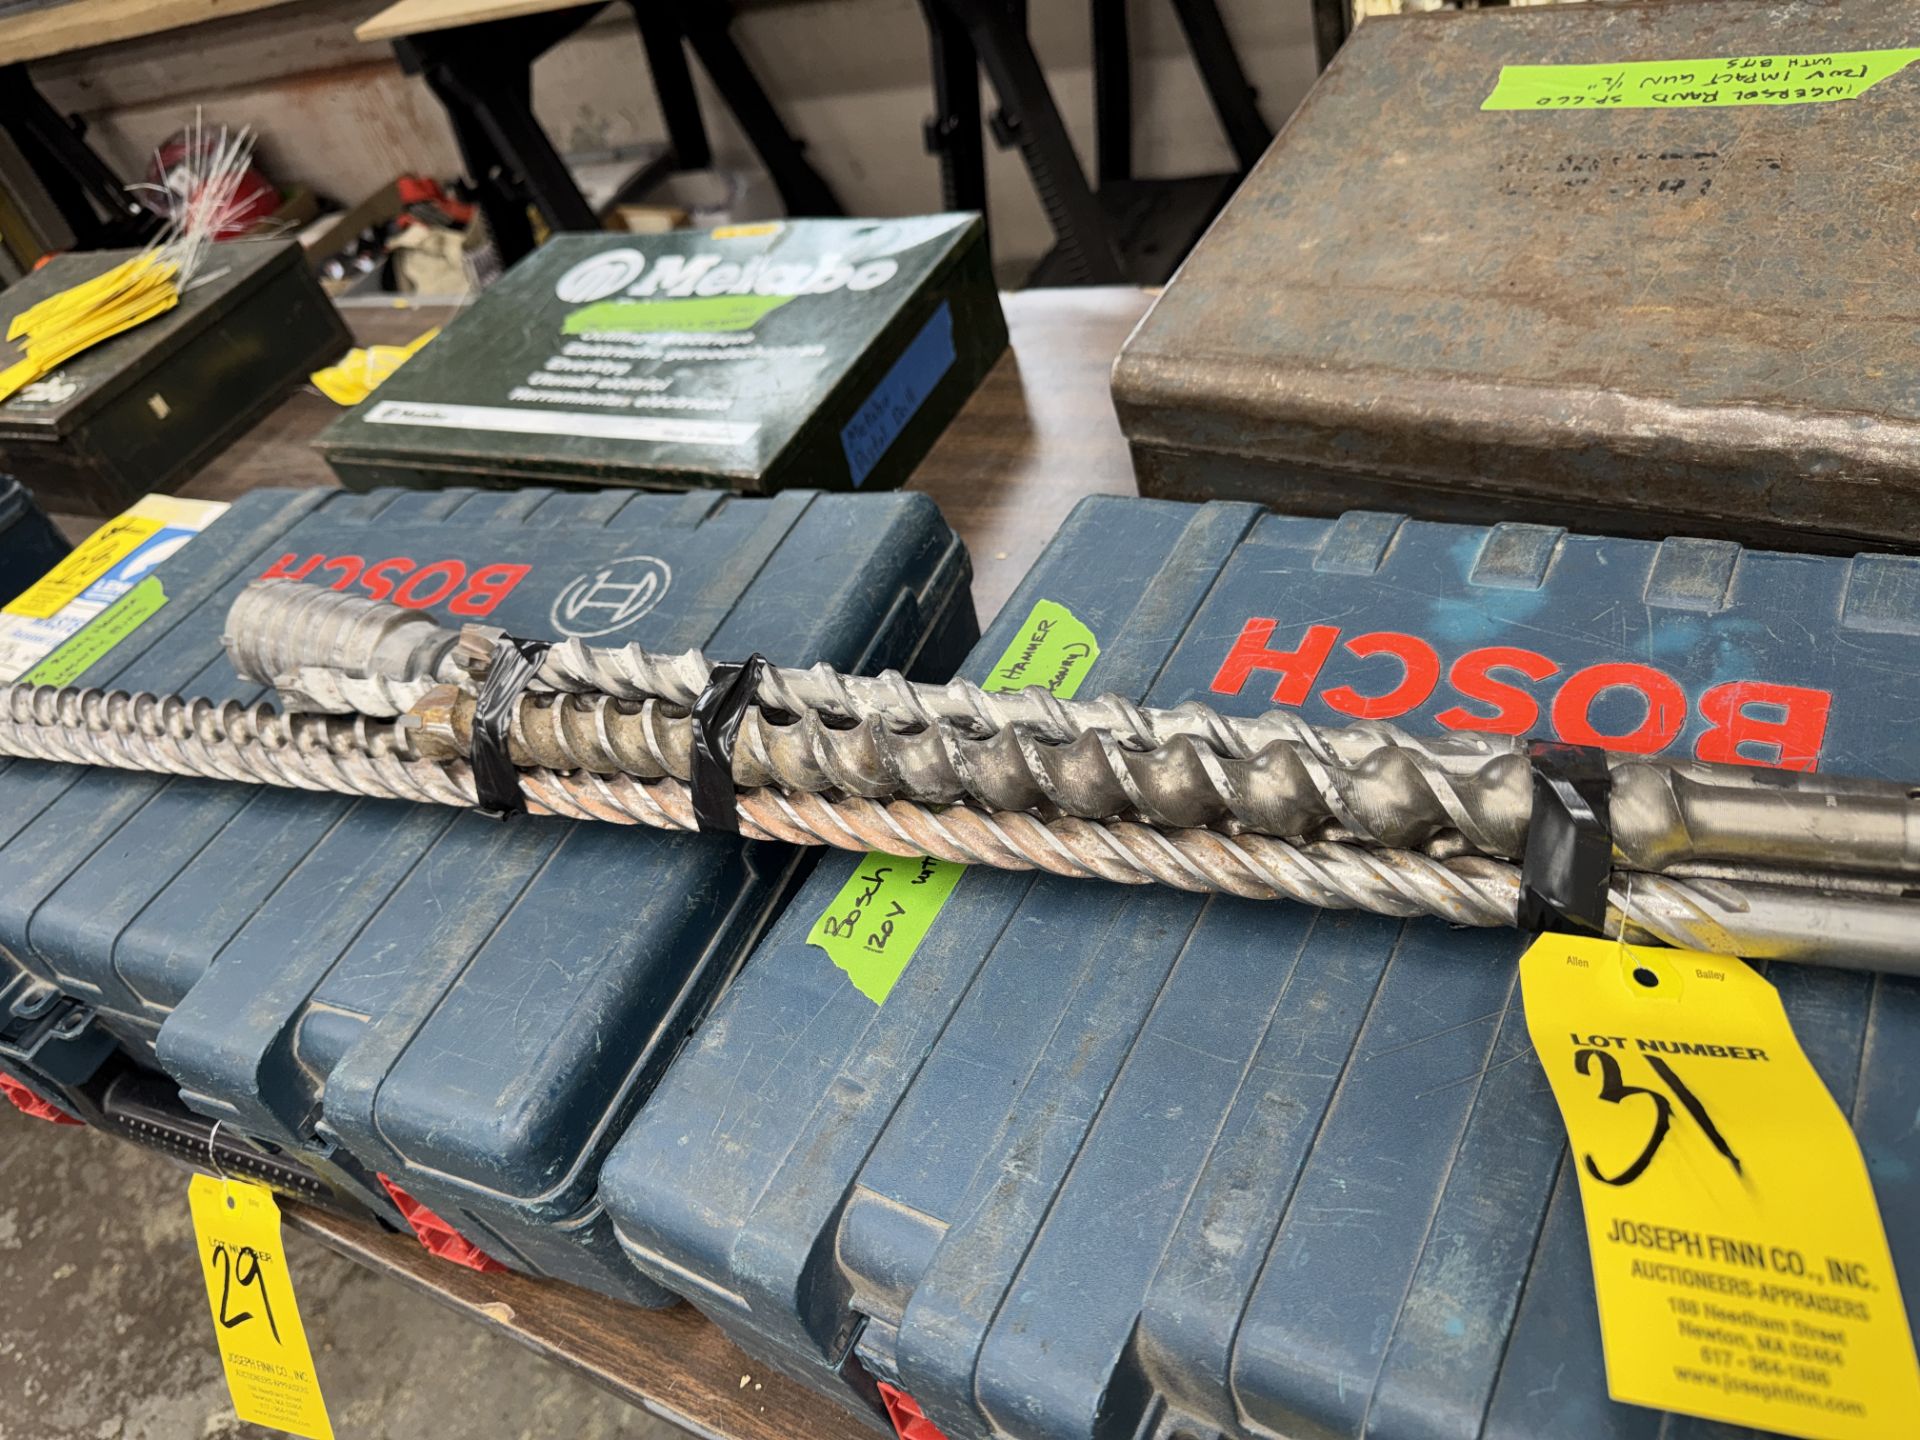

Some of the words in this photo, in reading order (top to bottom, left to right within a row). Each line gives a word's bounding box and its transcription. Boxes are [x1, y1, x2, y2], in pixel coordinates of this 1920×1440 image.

[1639, 73, 1695, 88] GUN
[1702, 71, 1790, 87] IMPACT
[1788, 57, 1833, 68] WITH
[1651, 90, 1719, 104] RAND
[628, 252, 899, 297] Metabo
[260, 553, 533, 617] BOSCH
[1000, 619, 1058, 680] HAMMER
[1209, 616, 1833, 774] BOSCH
[863, 900, 906, 954] 120V
[1566, 955, 1590, 968] Allen
[1695, 969, 1726, 981] Bailey
[1570, 1033, 1628, 1050] LOT
[1635, 1038, 1770, 1062] NUMBER
[1574, 1050, 1746, 1188] 31
[1607, 1218, 1703, 1259] JOSEPH
[1706, 1234, 1766, 1271] FINN
[1825, 1255, 1880, 1292] INC.
[212, 1245, 283, 1346] 29
